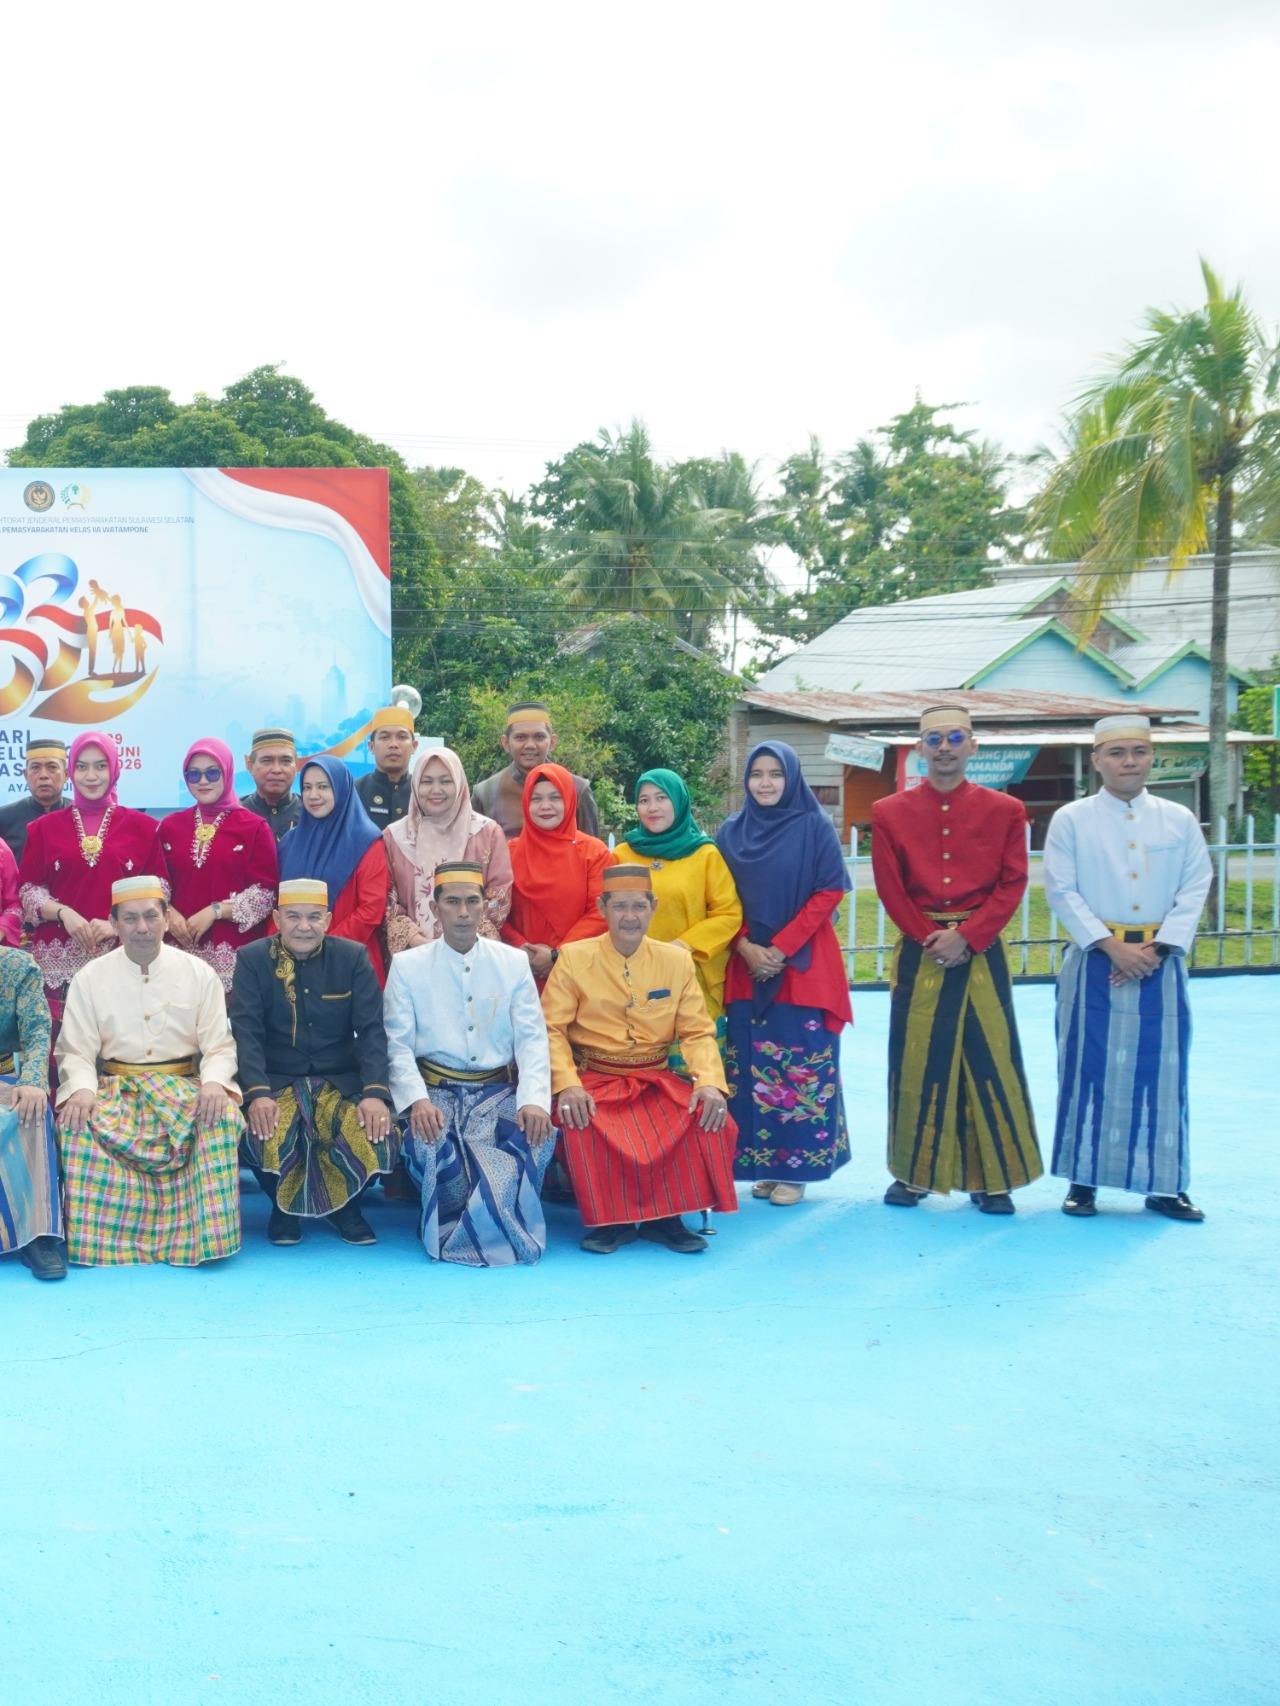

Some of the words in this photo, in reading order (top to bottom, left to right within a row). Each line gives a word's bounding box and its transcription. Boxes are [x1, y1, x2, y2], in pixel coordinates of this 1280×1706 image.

[26, 516, 60, 524] JENDERAL
[62, 516, 127, 524] PEMASYARAKATAN
[128, 516, 162, 524] SULAWESI
[164, 516, 194, 524] SELATAN
[2, 526, 68, 534] PEMASYARAKATAN
[70, 526, 91, 534] KELAS
[102, 526, 149, 534] WATAMPONE
[115, 746, 140, 757] UNI
